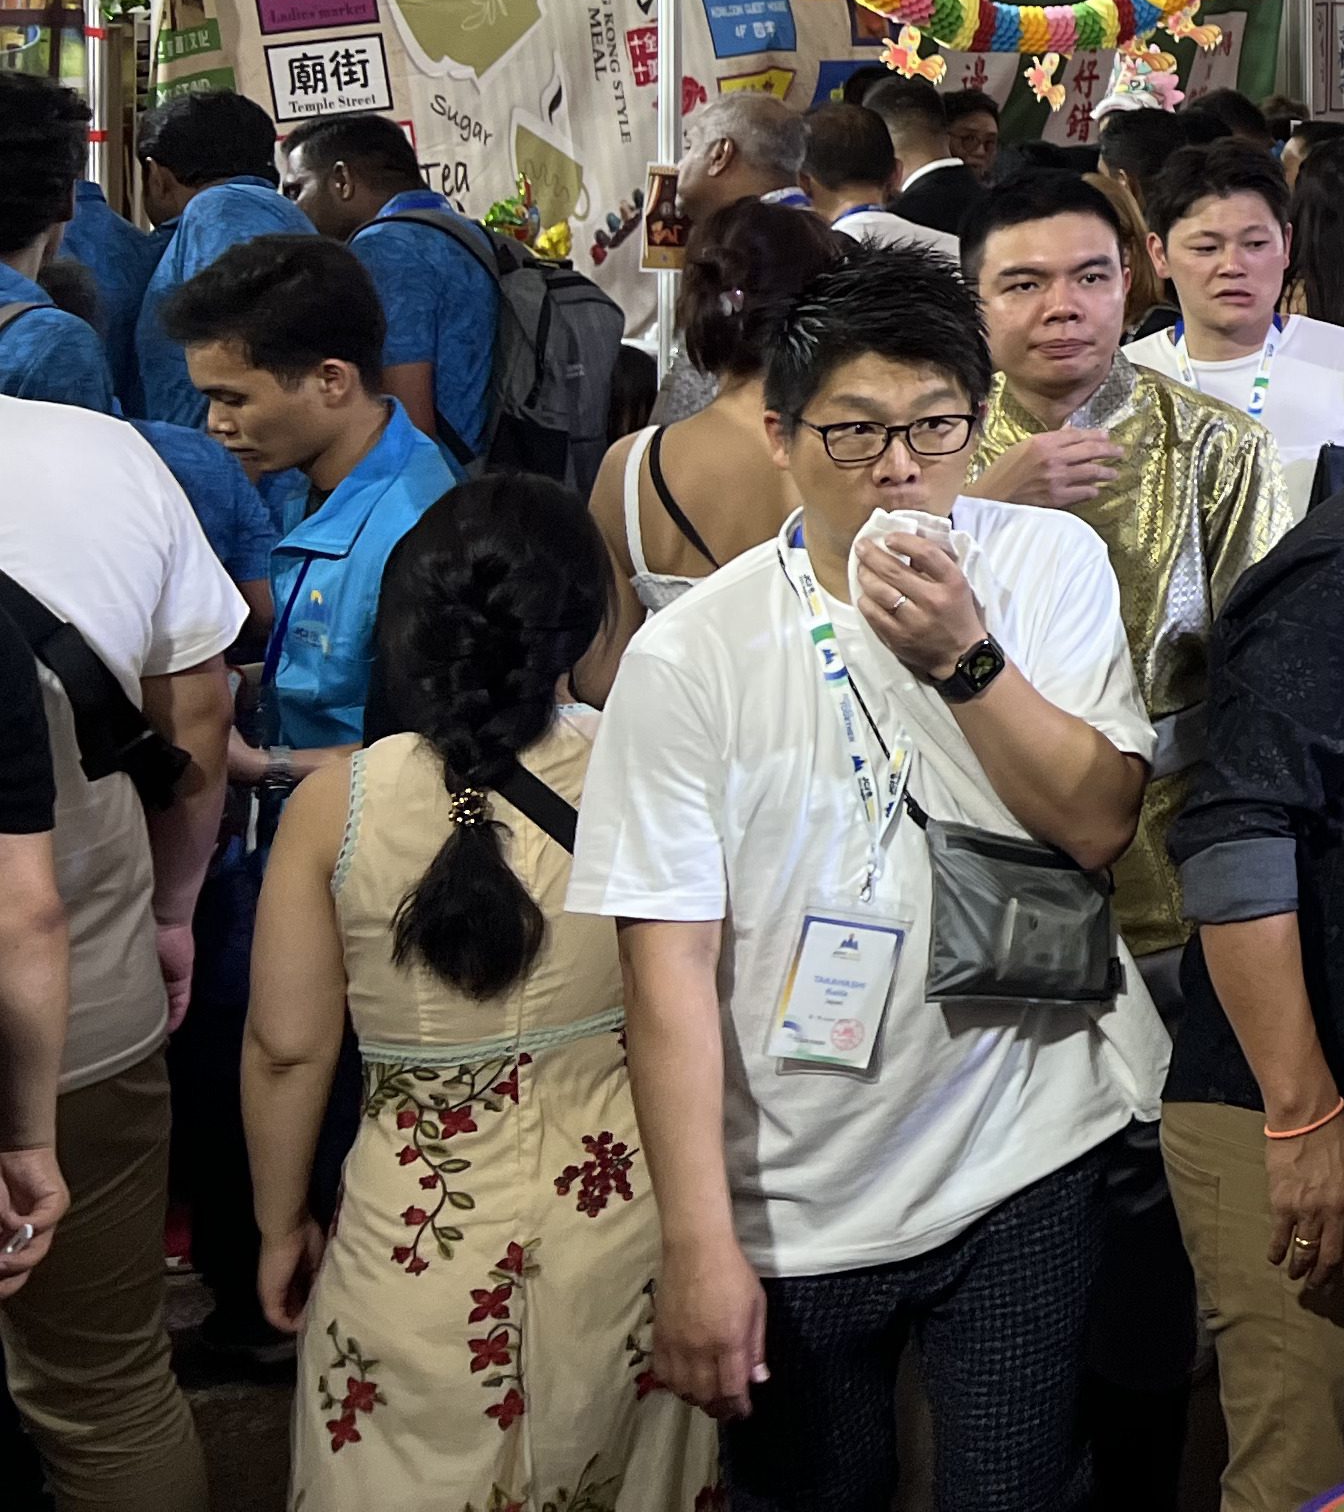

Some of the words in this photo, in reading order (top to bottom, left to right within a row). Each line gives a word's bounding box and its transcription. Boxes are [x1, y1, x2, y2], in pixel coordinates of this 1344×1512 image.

[587, 6, 608, 82] MEAL
[288, 48, 370, 96] 廟街
[602, 12, 621, 75] KONG
[612, 79, 632, 145] STYLE
[288, 96, 336, 115] Temple
[338, 93, 377, 111] Street
[430, 94, 494, 147] Sugar
